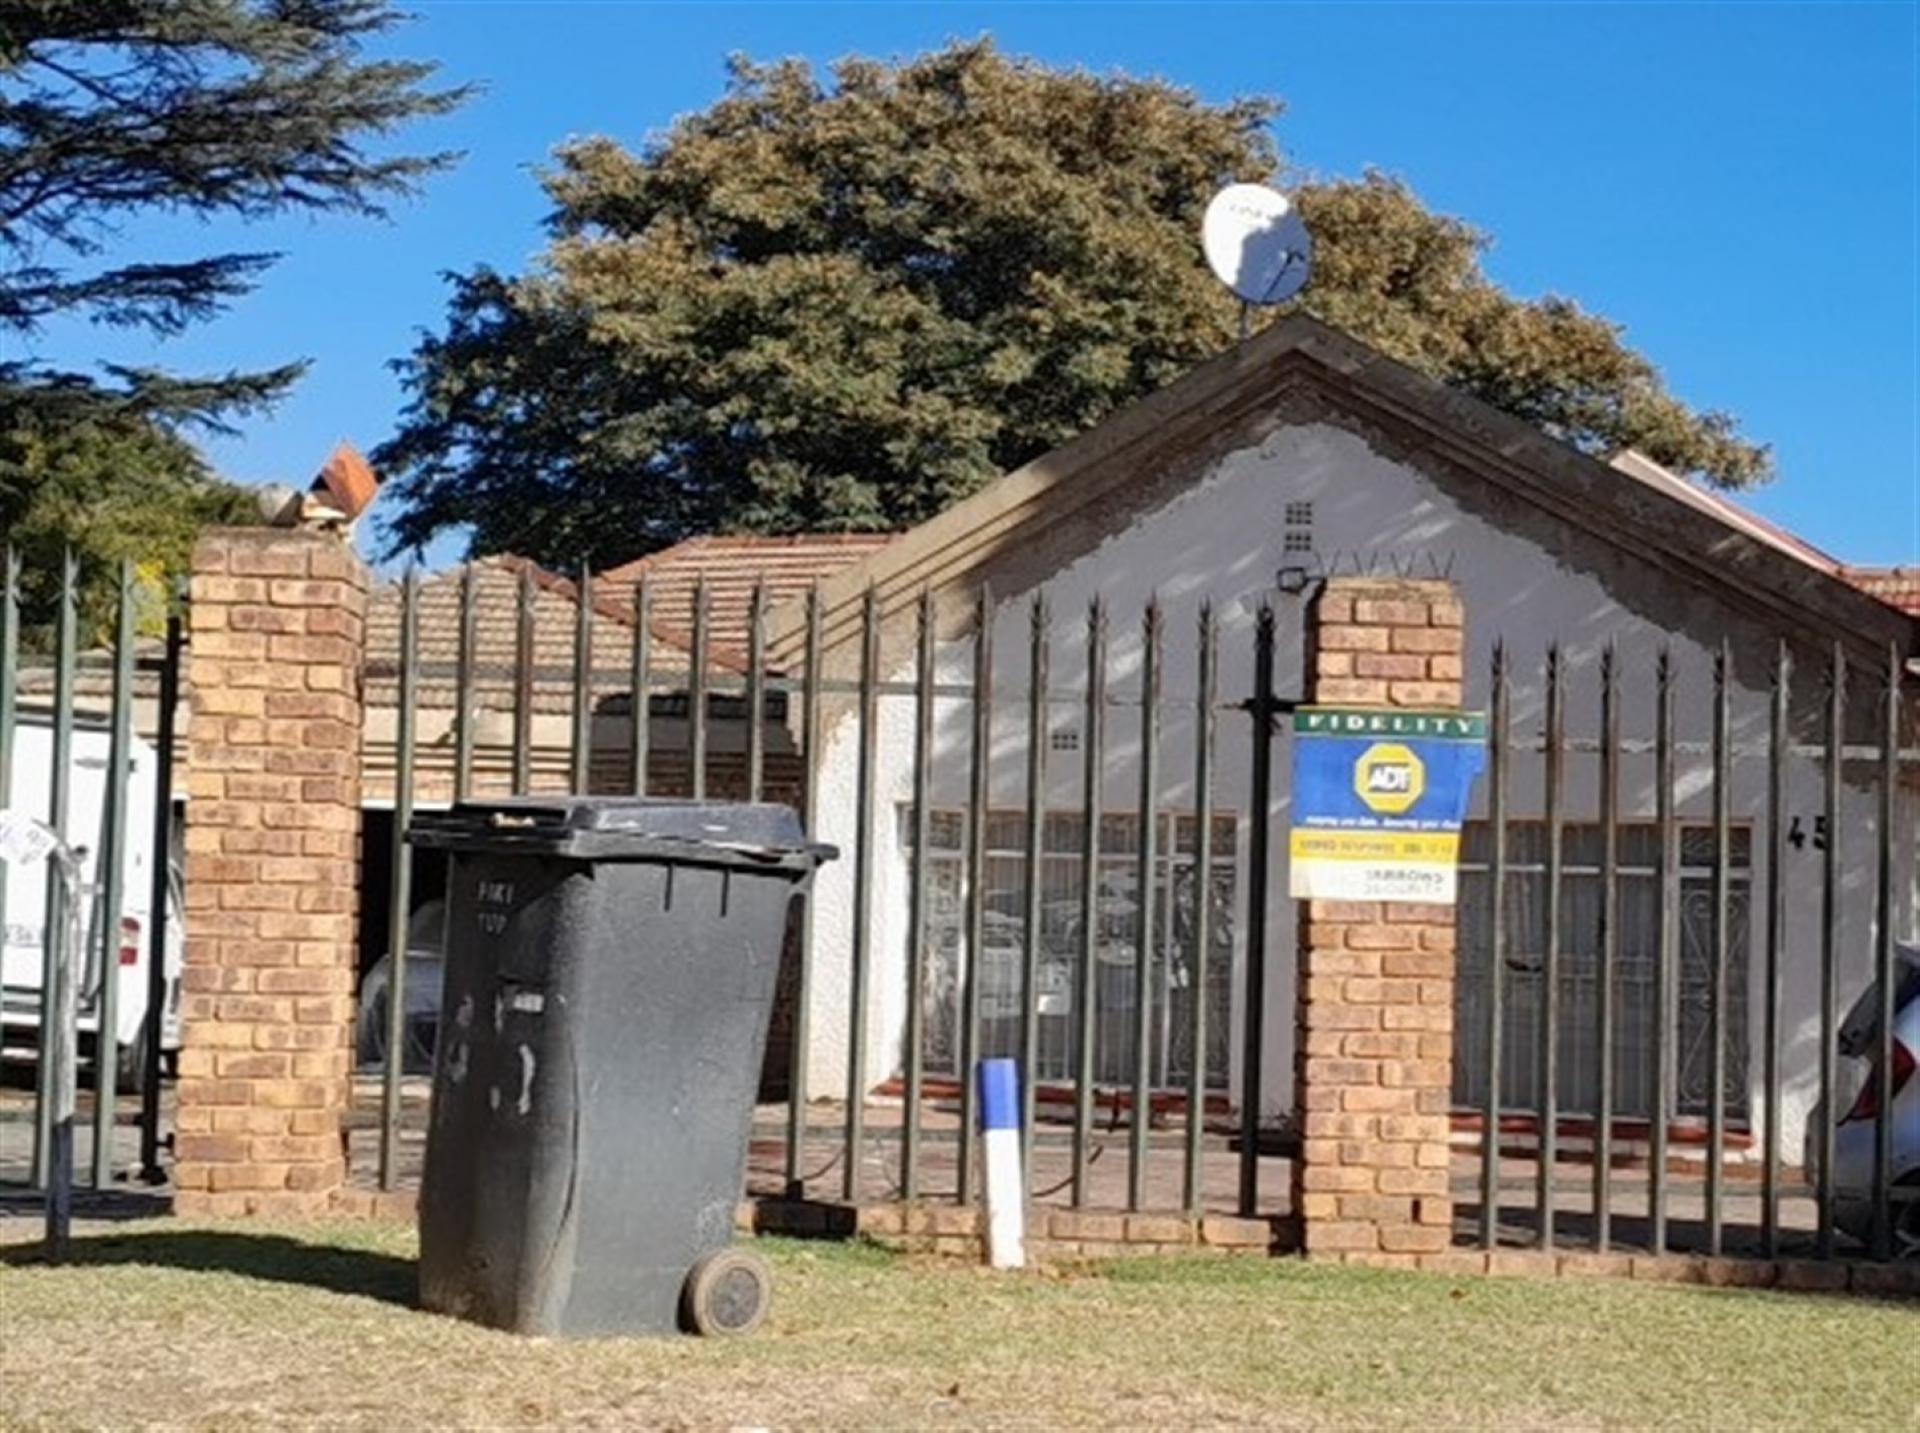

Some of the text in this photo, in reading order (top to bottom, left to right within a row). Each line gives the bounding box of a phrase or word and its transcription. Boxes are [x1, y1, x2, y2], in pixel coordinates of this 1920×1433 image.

[1307, 713, 1473, 734] FIDELITY
[1368, 765, 1412, 791] ADT
[1788, 815, 1828, 850] 45
